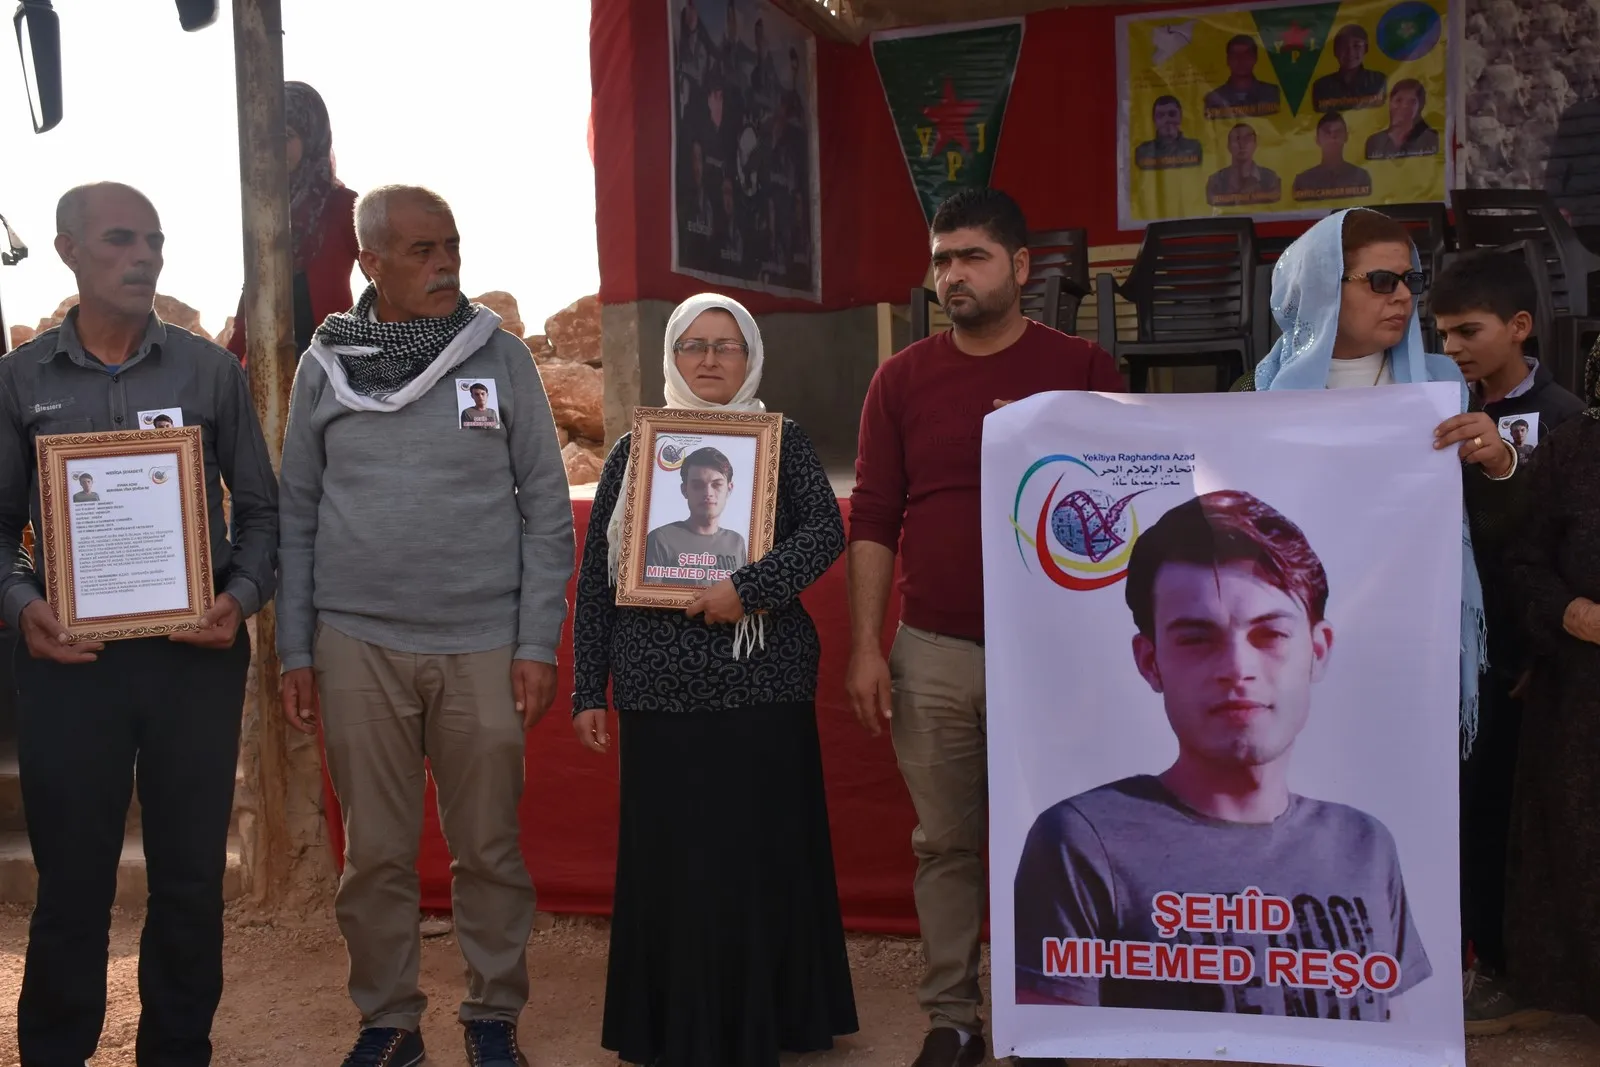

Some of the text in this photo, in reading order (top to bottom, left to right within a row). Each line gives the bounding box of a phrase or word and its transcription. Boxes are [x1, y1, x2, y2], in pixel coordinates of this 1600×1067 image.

[1119, 453, 1170, 462] Raghandina
[1172, 453, 1195, 461] Azad
[1100, 465, 1122, 476] الحر
[1167, 465, 1195, 473] اتحاد
[679, 552, 716, 565] ŞEHÎD
[647, 566, 704, 580] MIHEMED
[1153, 887, 1293, 936] ŞEHÎD
[1044, 939, 1399, 996] MIHEMED REŞO
